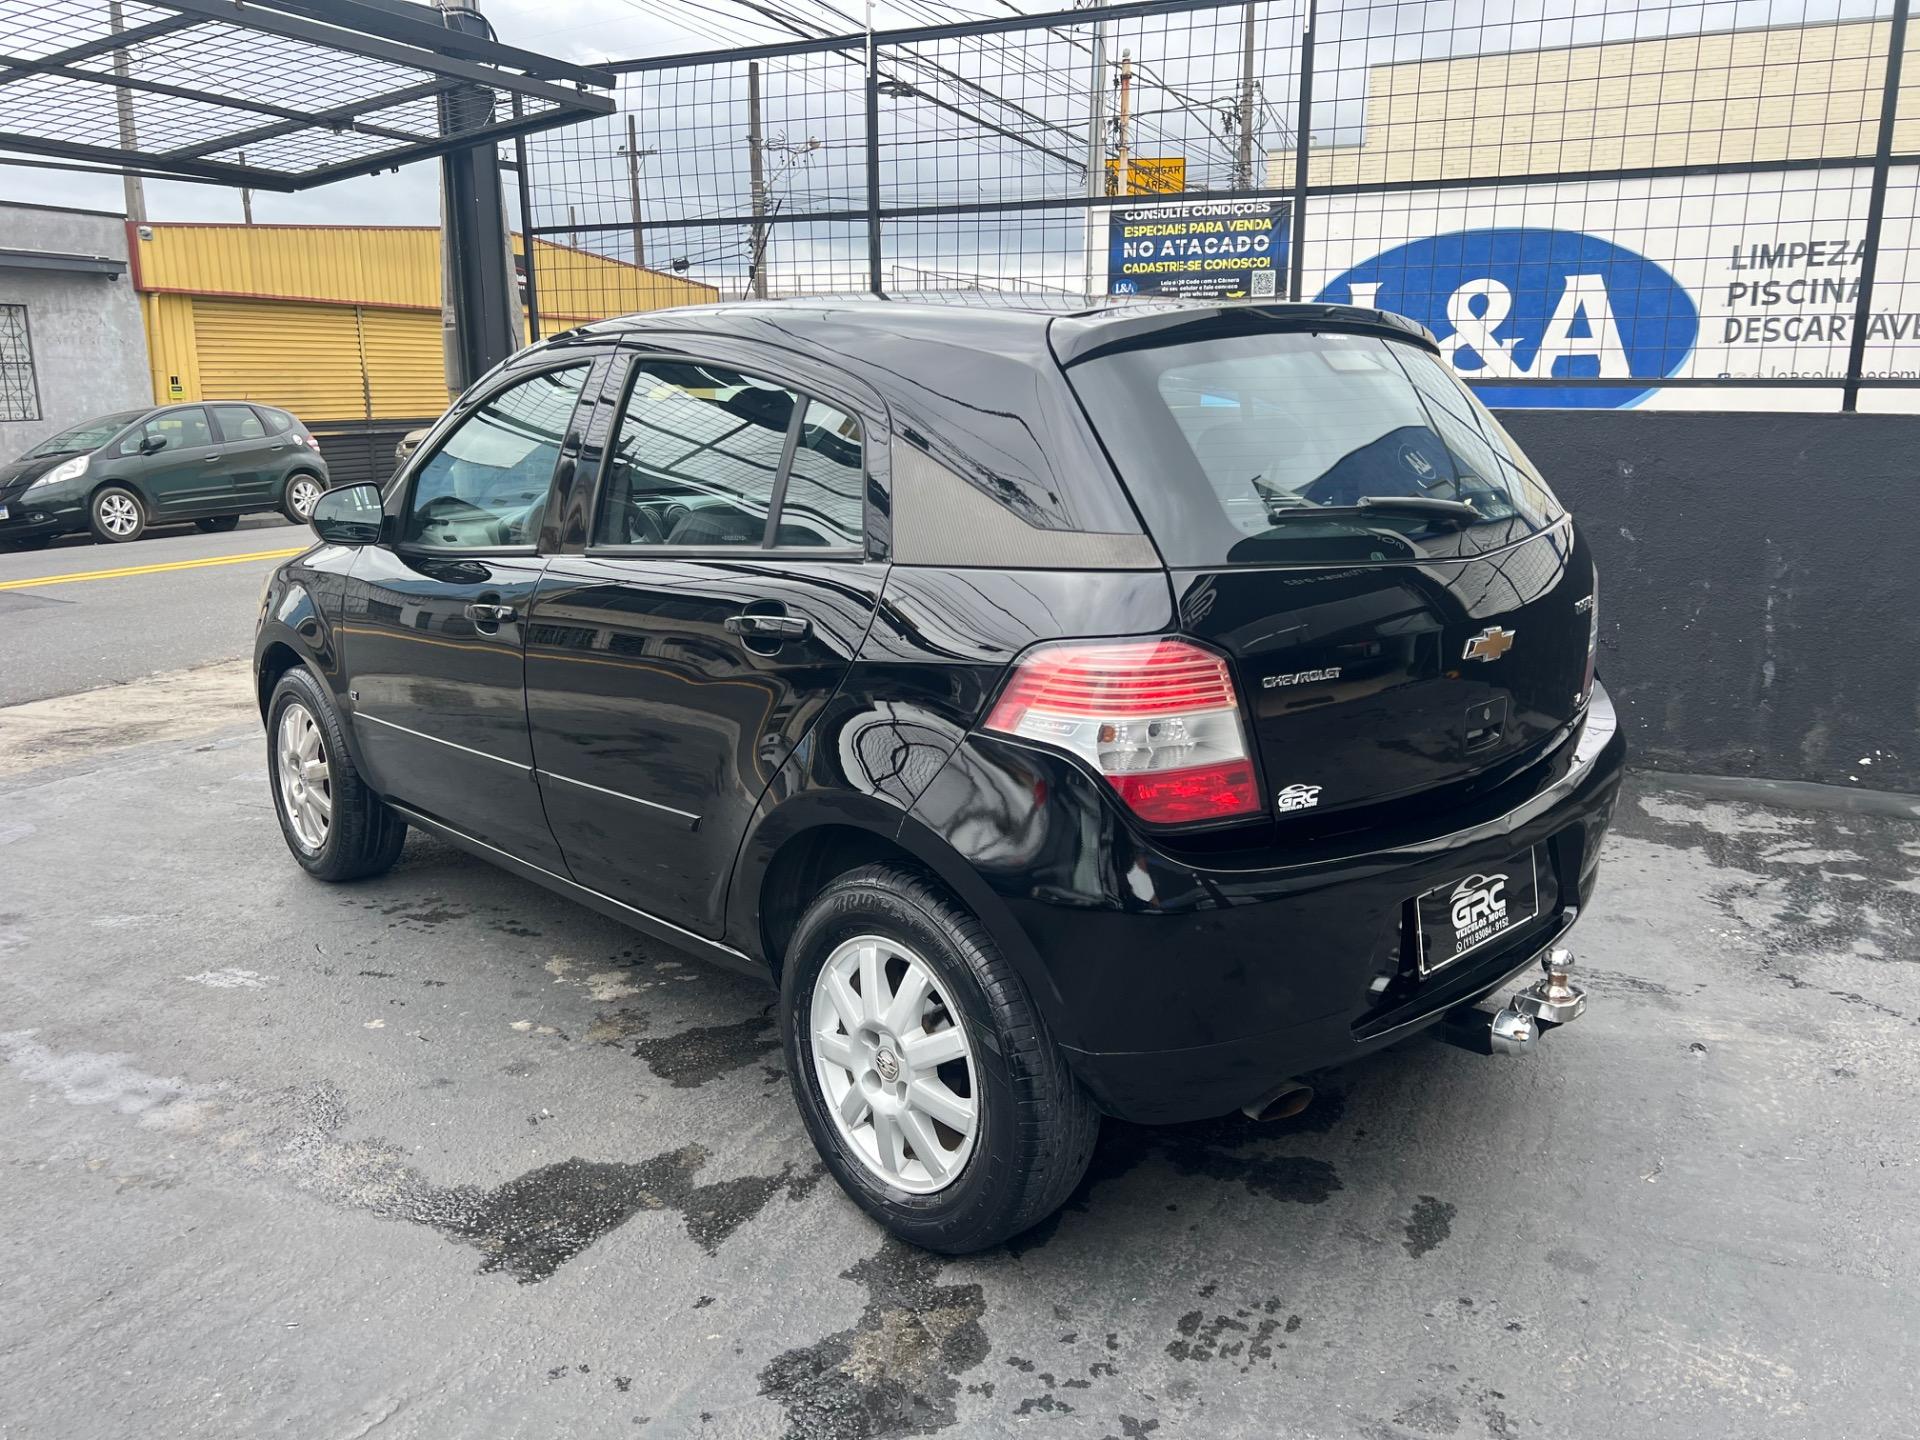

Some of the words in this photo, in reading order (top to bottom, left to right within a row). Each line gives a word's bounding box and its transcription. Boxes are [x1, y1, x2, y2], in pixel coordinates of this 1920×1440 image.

[1124, 206, 1190, 221] CONSULTE
[1124, 223, 1187, 238] ESPECIAIS
[1189, 221, 1224, 234] PARA
[1227, 218, 1272, 231] VENDA
[1123, 241, 1154, 258] NO
[1160, 235, 1270, 257] ATACADO
[1123, 260, 1201, 274] CADASTRE-SE
[1204, 257, 1271, 270] CONOSCO!
[1262, 667, 1342, 688] CHEVROLET
[1278, 789, 1319, 808] GRC
[1452, 880, 1506, 929] GRC
